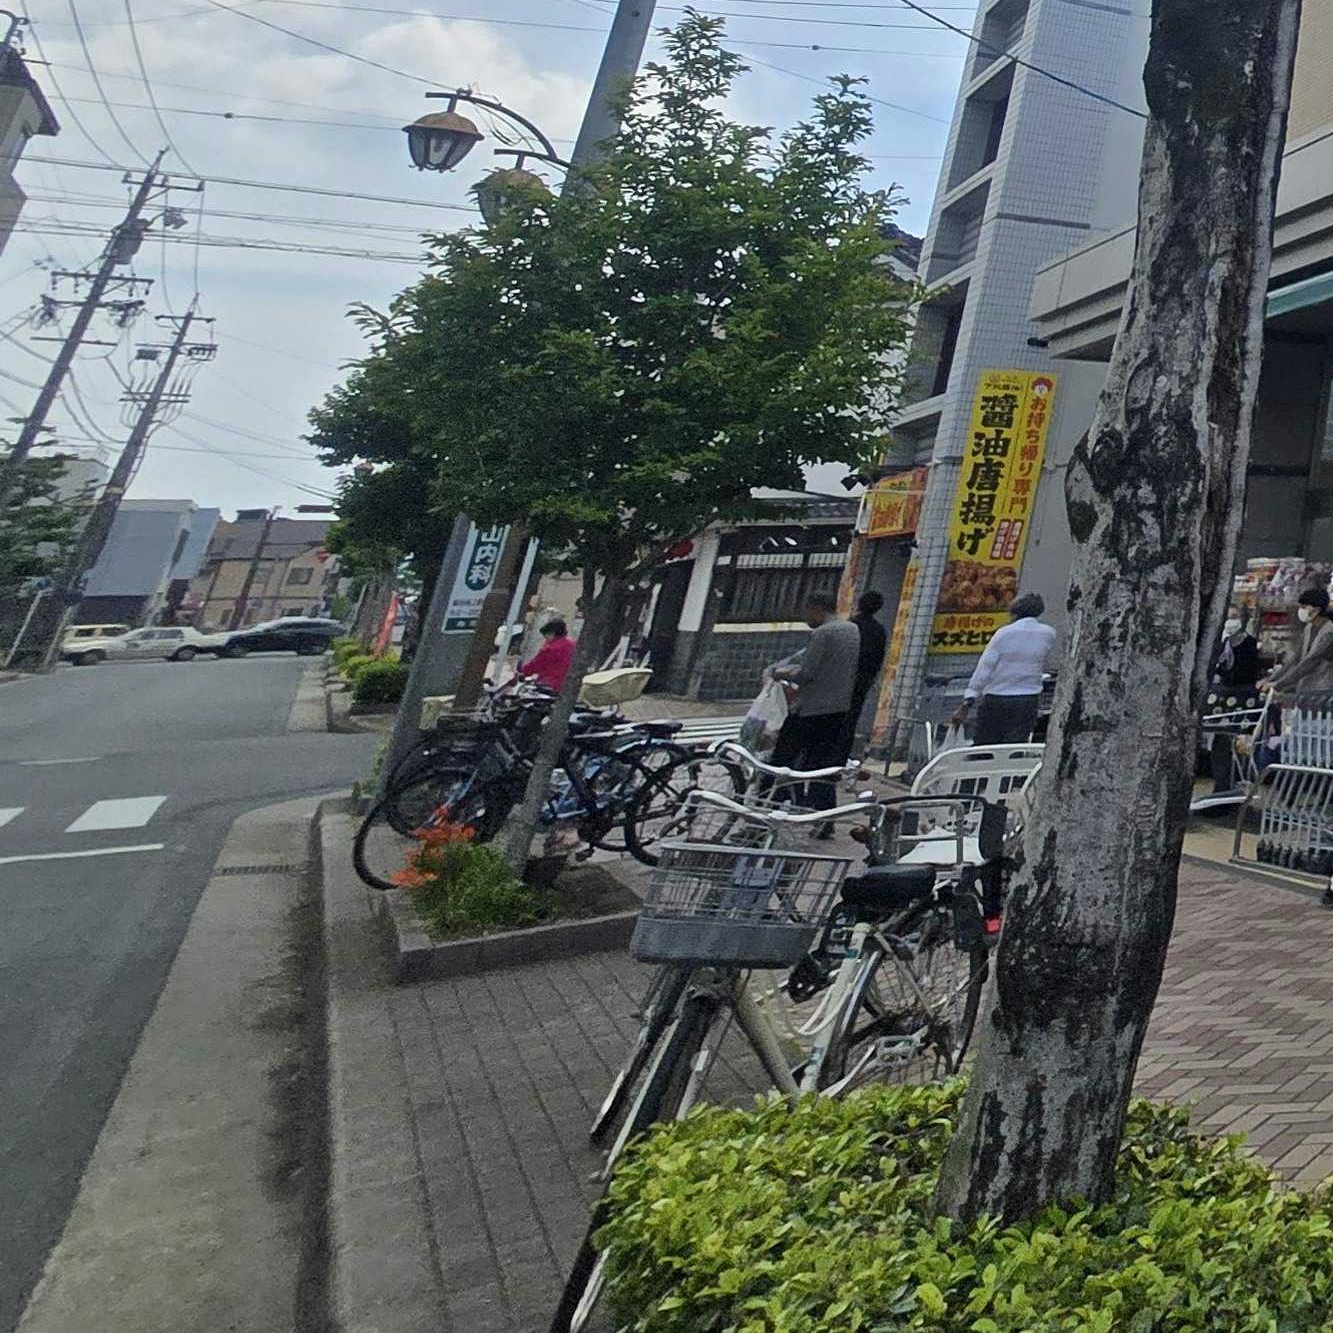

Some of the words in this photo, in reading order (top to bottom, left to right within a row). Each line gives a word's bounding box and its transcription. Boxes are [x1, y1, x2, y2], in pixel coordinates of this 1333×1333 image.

[1007, 396, 1047, 514] お持ち帰り専門
